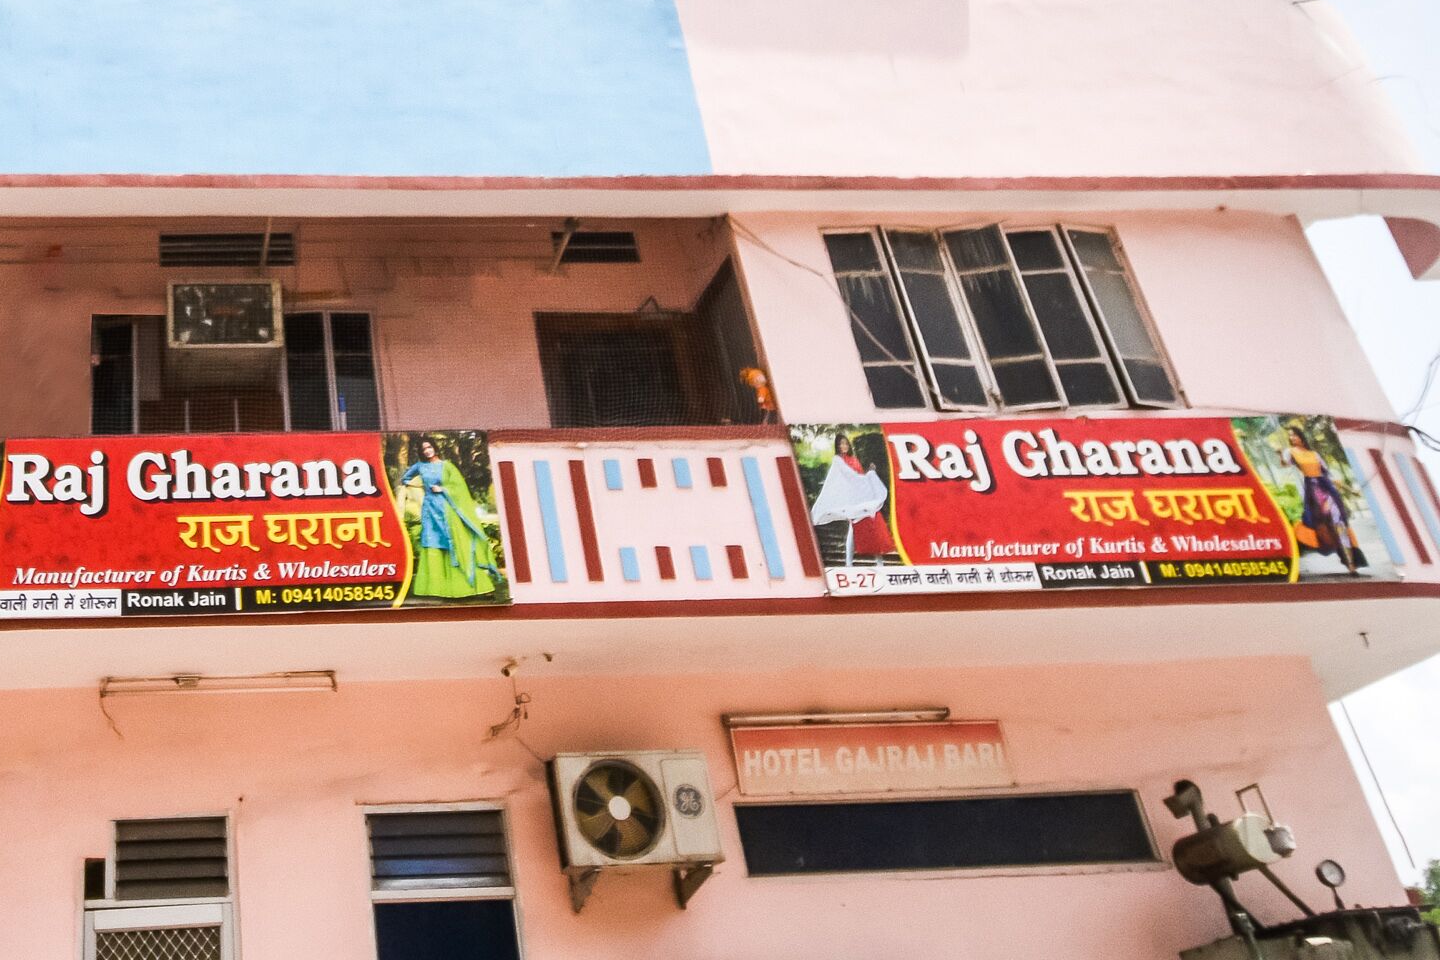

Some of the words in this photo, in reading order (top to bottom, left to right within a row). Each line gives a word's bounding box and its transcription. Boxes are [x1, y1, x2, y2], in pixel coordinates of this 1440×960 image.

[888, 429, 993, 493] Raj
[1002, 428, 1241, 478] Gharana
[6, 451, 107, 515] Raj
[126, 449, 377, 501] Gharana
[1063, 489, 1150, 527] राज
[1143, 488, 1271, 525] घराना
[176, 514, 260, 553] राज
[262, 511, 392, 550] घराना
[929, 540, 1060, 561] Manufacturer
[1065, 537, 1084, 558] of
[1089, 537, 1146, 554] Kurtis
[1151, 535, 1168, 553] &
[1170, 534, 1283, 552] Wholesalers
[12, 564, 155, 589] Manufacturer
[159, 565, 184, 587] of
[187, 565, 248, 583] Kurtis
[253, 563, 272, 580] &
[277, 559, 397, 579] Wholesalers
[836, 573, 877, 588] B-27
[1042, 564, 1097, 581] Ronak
[1099, 563, 1135, 580] Jain
[1160, 564, 1182, 578] M:
[1184, 561, 1289, 578] 09414058545
[127, 593, 184, 608] Ronak
[188, 591, 226, 607] Jain
[256, 590, 277, 604] M:
[282, 586, 395, 604] 09414058545
[743, 747, 829, 778] HOTEL
[835, 745, 936, 775] GAJRAJ
[943, 742, 1004, 771] BARI
